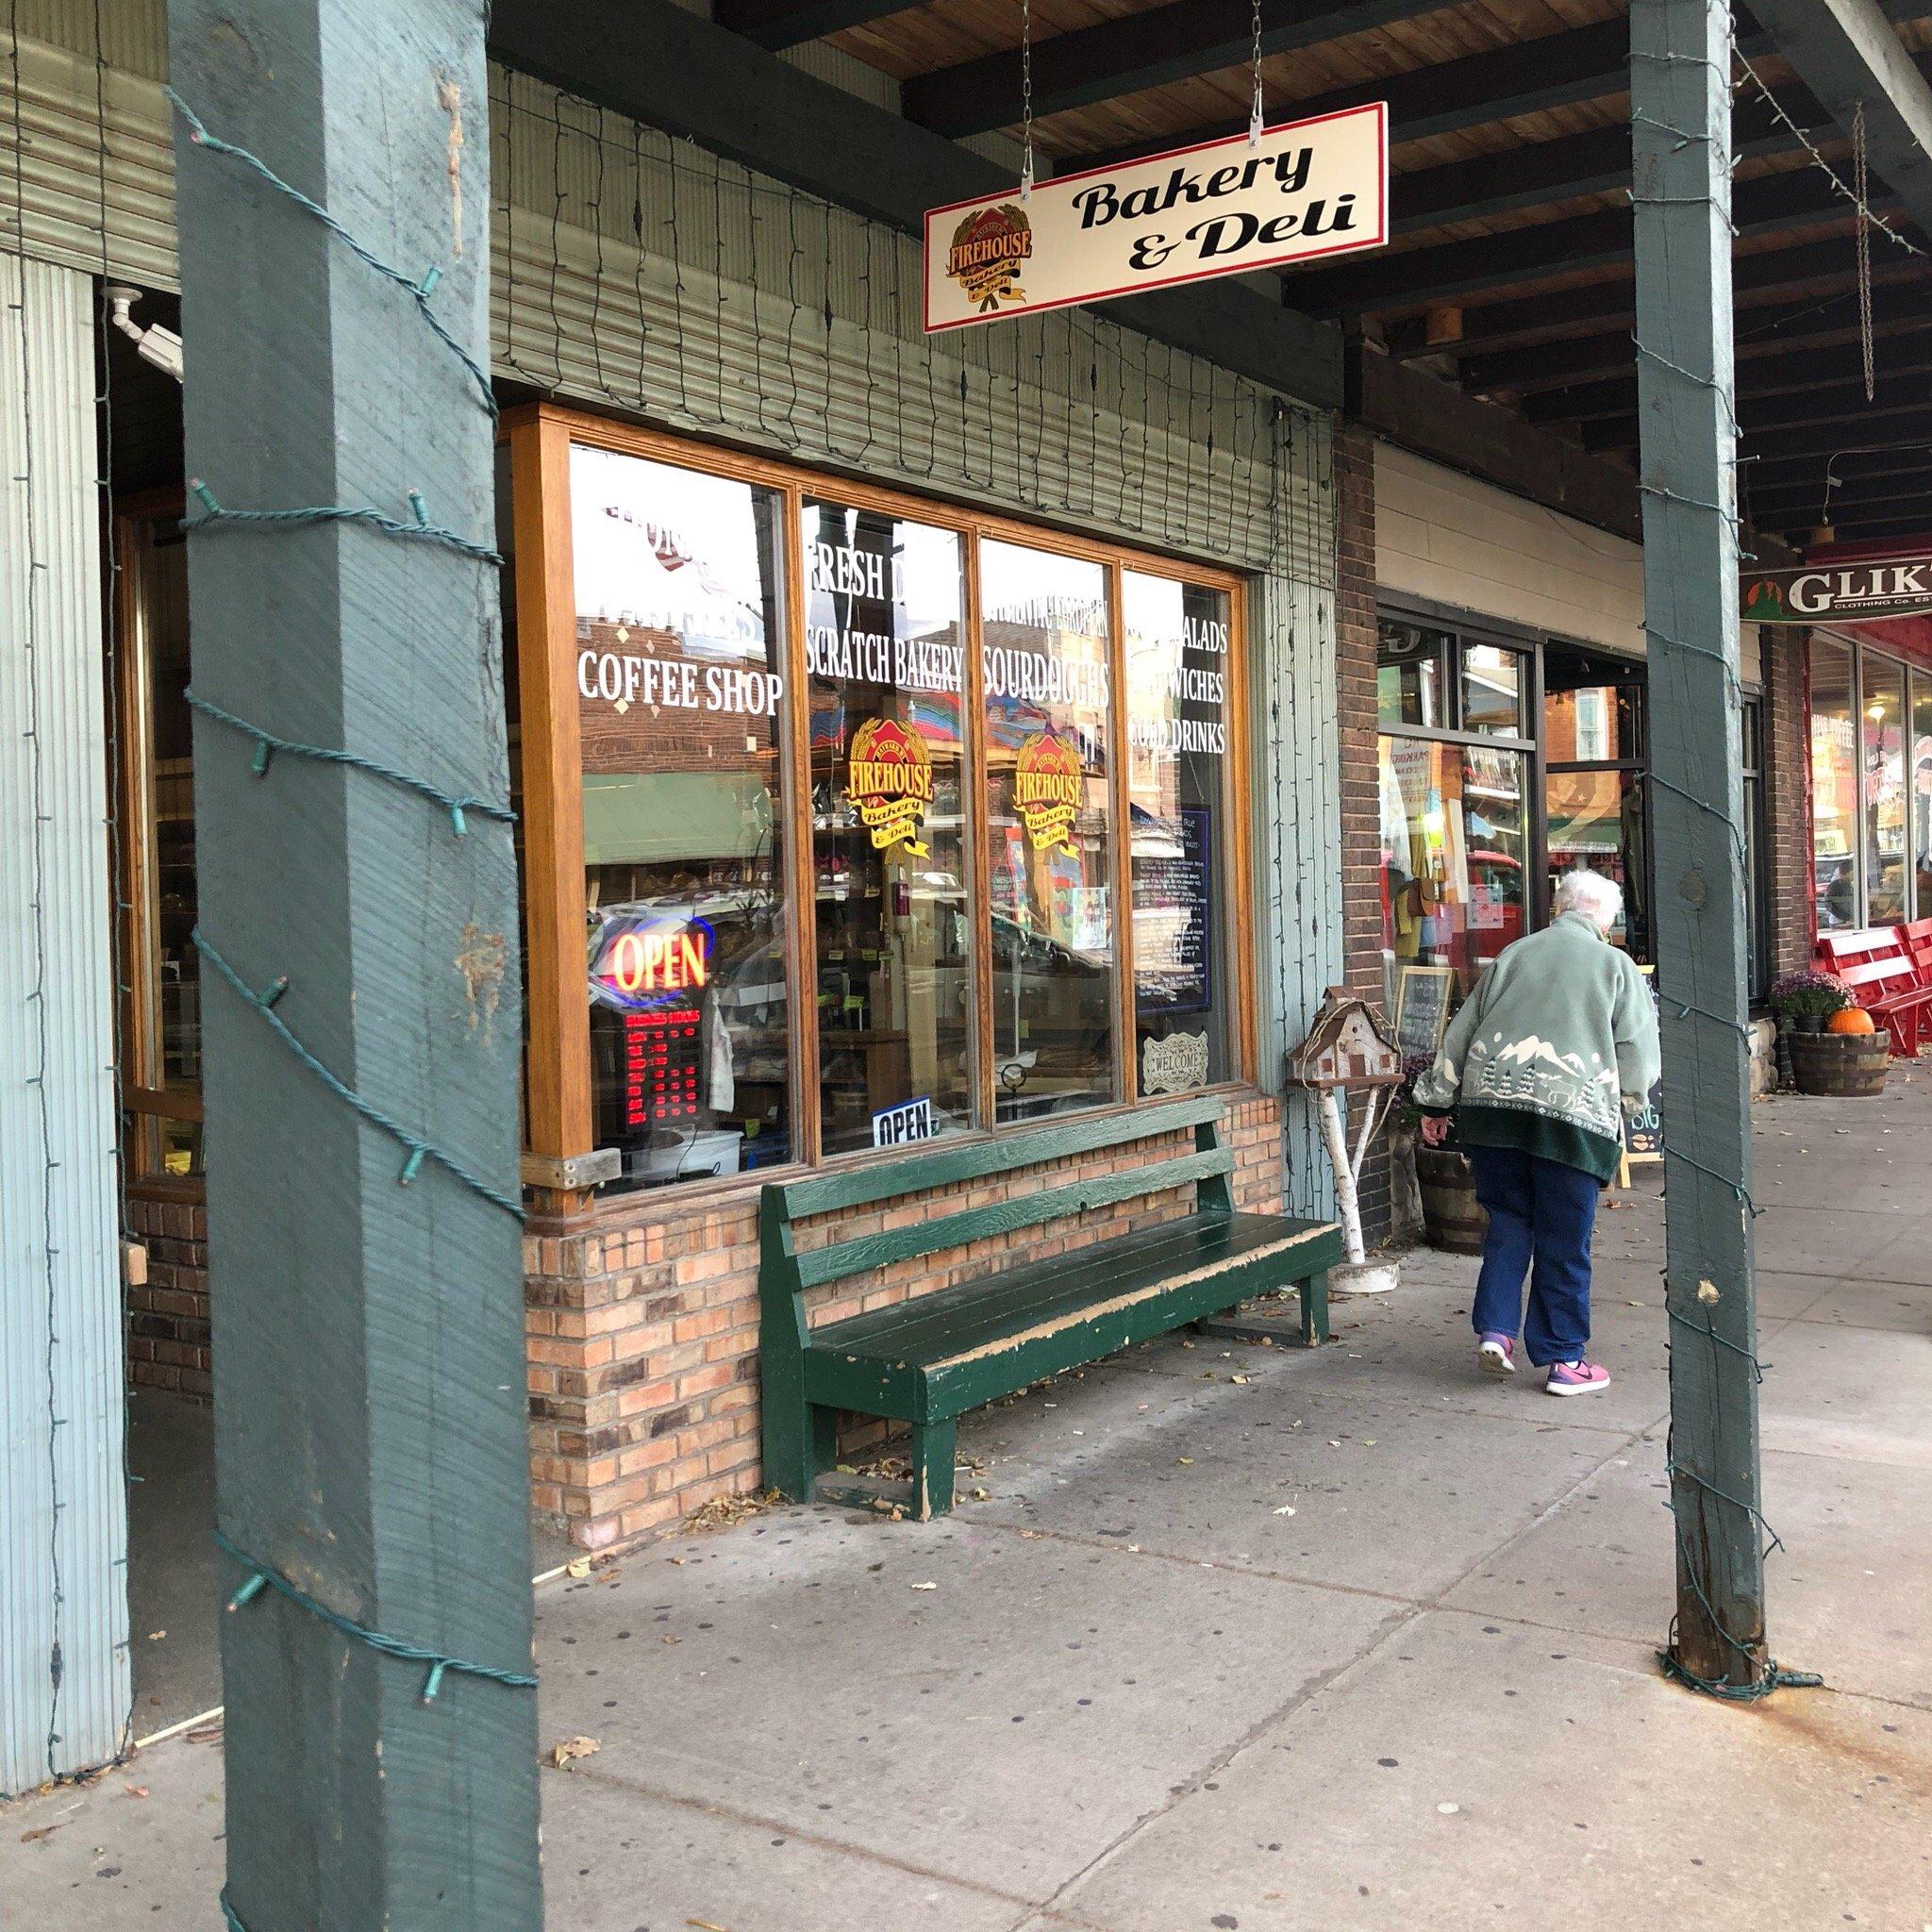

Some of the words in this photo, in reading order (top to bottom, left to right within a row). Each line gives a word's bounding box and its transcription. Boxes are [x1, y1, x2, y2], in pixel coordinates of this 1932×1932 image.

[1072, 147, 1313, 229] Bakery
[1128, 234, 1181, 271] &
[1186, 193, 1357, 259] Deli
[950, 230, 1031, 274] FIREHOUSE
[962, 259, 1017, 286] Bakery
[1835, 600, 1890, 608] CLOTHING
[1182, 616, 1227, 654] ALADS
[807, 625, 891, 684] SCRATCH
[894, 638, 963, 691] BAKERY
[984, 645, 1108, 708] SOURDOUGHS
[577, 651, 698, 708] COFFEE
[706, 666, 783, 716] SHOP
[1168, 666, 1224, 704] WICHES
[1173, 718, 1225, 755] DRINKS
[850, 761, 933, 800] FIREHOUSE
[1016, 772, 1083, 809] FIREHOUSE
[864, 801, 920, 824] Bakery
[1027, 808, 1072, 827] Bakery
[875, 836, 884, 844] &
[888, 824, 912, 839] Deli
[1047, 830, 1065, 841] Deli
[614, 933, 705, 991] OPEN
[1157, 1052, 1198, 1071] WELCOME
[879, 1102, 928, 1146] OPEN
